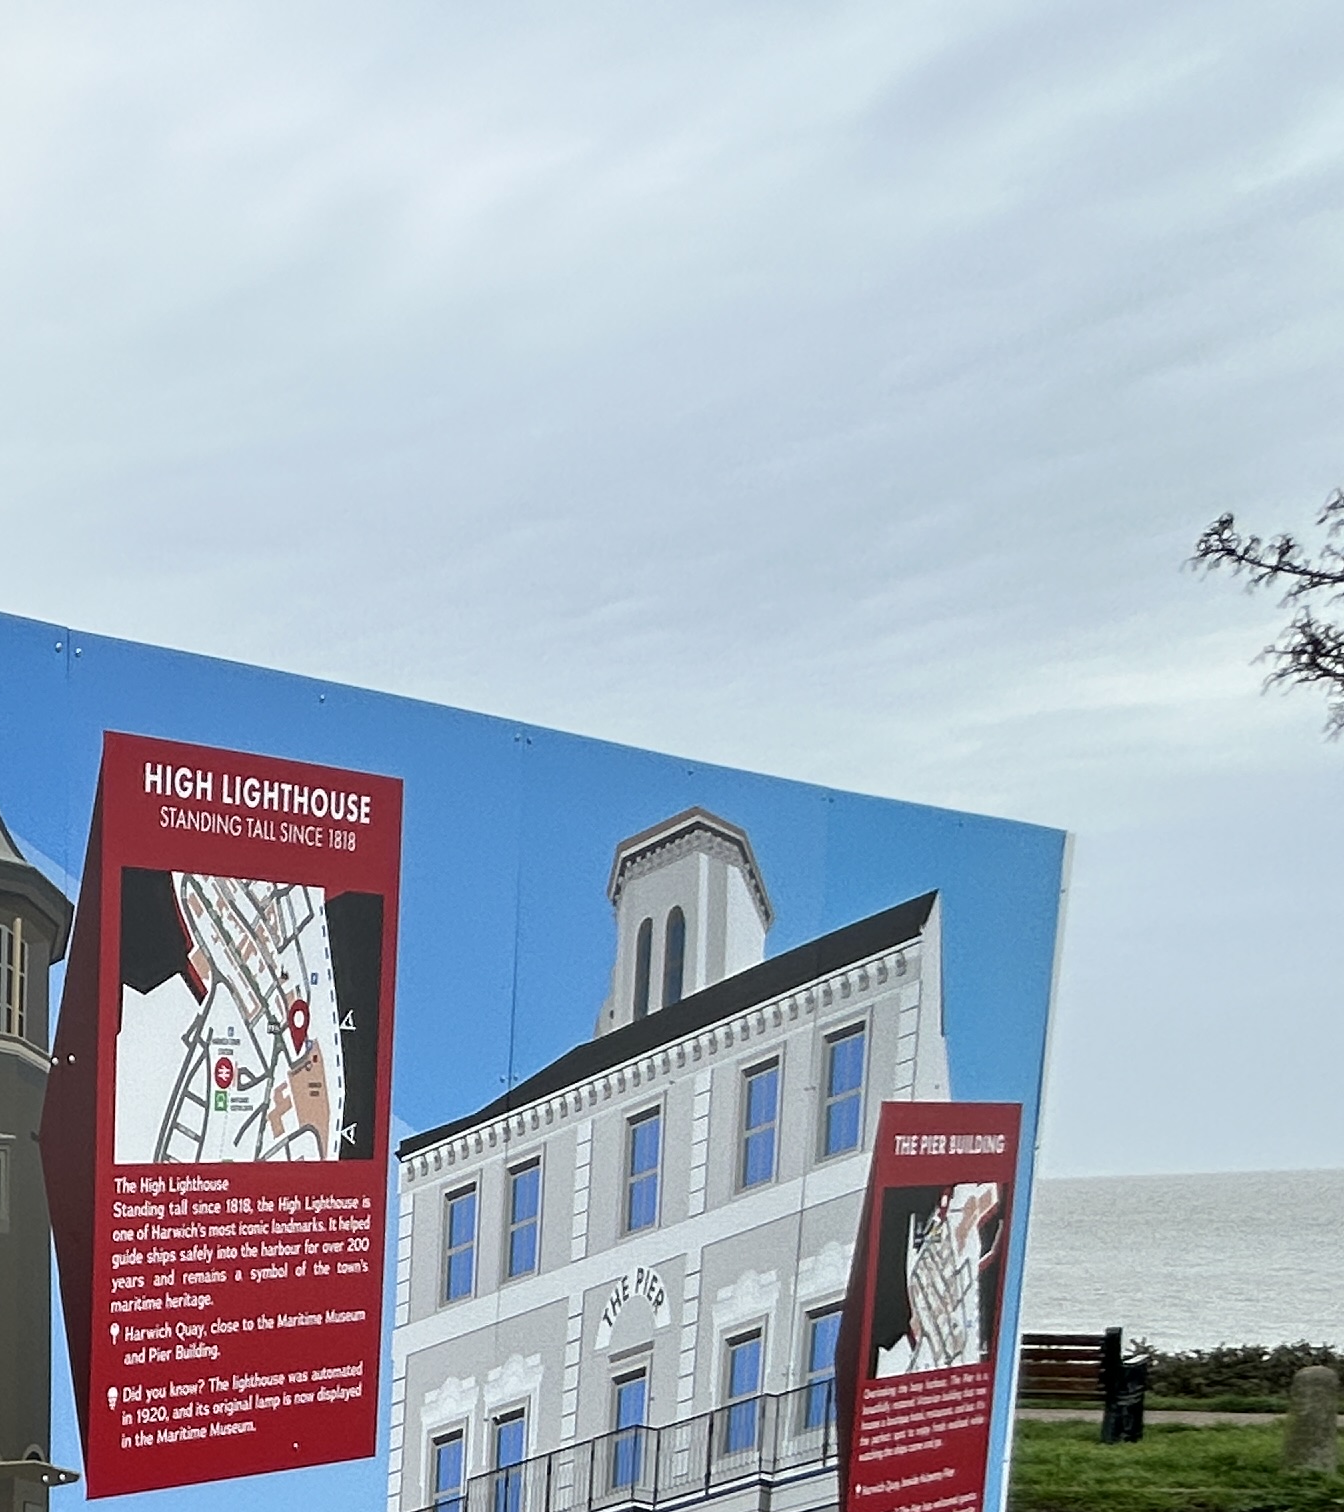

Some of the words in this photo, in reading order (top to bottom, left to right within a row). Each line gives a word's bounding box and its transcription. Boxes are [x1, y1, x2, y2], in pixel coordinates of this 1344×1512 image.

[145, 763, 212, 801] HIGH
[223, 774, 370, 824] LIGHTHOUSE
[160, 806, 241, 836] STANDING
[246, 818, 276, 841] TALL
[280, 823, 322, 847] SINCE
[329, 829, 355, 851] 1818
[895, 1135, 918, 1155] THE
[919, 1135, 947, 1155] PIER
[949, 1135, 1005, 1154] BUILDING
[113, 1177, 137, 1193] The
[139, 1176, 165, 1195] High
[168, 1175, 229, 1194] Lighthouse
[112, 1200, 165, 1219] Standing
[168, 1199, 188, 1216] tall
[191, 1199, 221, 1215] since
[256, 1196, 274, 1212] the
[278, 1195, 301, 1214] High
[304, 1194, 359, 1213] Lighthouse
[361, 1194, 371, 1208] is
[112, 1228, 134, 1241] one
[136, 1223, 149, 1240] of
[151, 1221, 206, 1239] Harwich's
[208, 1222, 236, 1237] most
[238, 1219, 269, 1235] iconic
[328, 1216, 337, 1231] It
[338, 1214, 371, 1233] helped
[111, 1247, 143, 1269] guide
[146, 1246, 176, 1266] ships
[179, 1244, 213, 1263] safely
[216, 1243, 238, 1259] into
[240, 1242, 258, 1257] the
[260, 1240, 301, 1256] harbour
[304, 1239, 319, 1254] for
[321, 1241, 344, 1253] over
[346, 1236, 369, 1252] 200
[110, 1275, 144, 1293] years
[152, 1269, 174, 1286] and
[182, 1267, 227, 1284] remains
[234, 1269, 242, 1281] a
[249, 1262, 288, 1283] symbol
[294, 1261, 306, 1277] of
[313, 1260, 330, 1275] the
[336, 1258, 368, 1273] town's
[110, 1294, 162, 1313] maritime
[602, 1275, 629, 1327] THE
[635, 1267, 664, 1315] PIER
[124, 1322, 172, 1341] Harwich
[210, 1318, 239, 1334] close
[242, 1318, 254, 1330] to
[256, 1314, 274, 1329] the
[276, 1311, 322, 1328] Maritime
[324, 1309, 365, 1323] Museum
[123, 1347, 145, 1365] and
[148, 1346, 172, 1362] Pier
[122, 1384, 142, 1402] Did
[145, 1386, 166, 1402] you
[169, 1378, 205, 1397] know?
[207, 1376, 229, 1392] The
[231, 1372, 285, 1392] lighthouse
[287, 1371, 308, 1383] was
[310, 1360, 363, 1381] automated
[121, 1410, 132, 1425] in
[172, 1401, 193, 1419] and
[194, 1401, 210, 1416] its
[212, 1394, 253, 1416] original
[254, 1393, 280, 1410] lamp
[282, 1391, 291, 1405] is
[293, 1392, 314, 1404] now
[316, 1382, 362, 1403] displayed
[120, 1433, 131, 1448] in
[134, 1429, 153, 1447] the
[156, 1425, 207, 1443] Maritime
